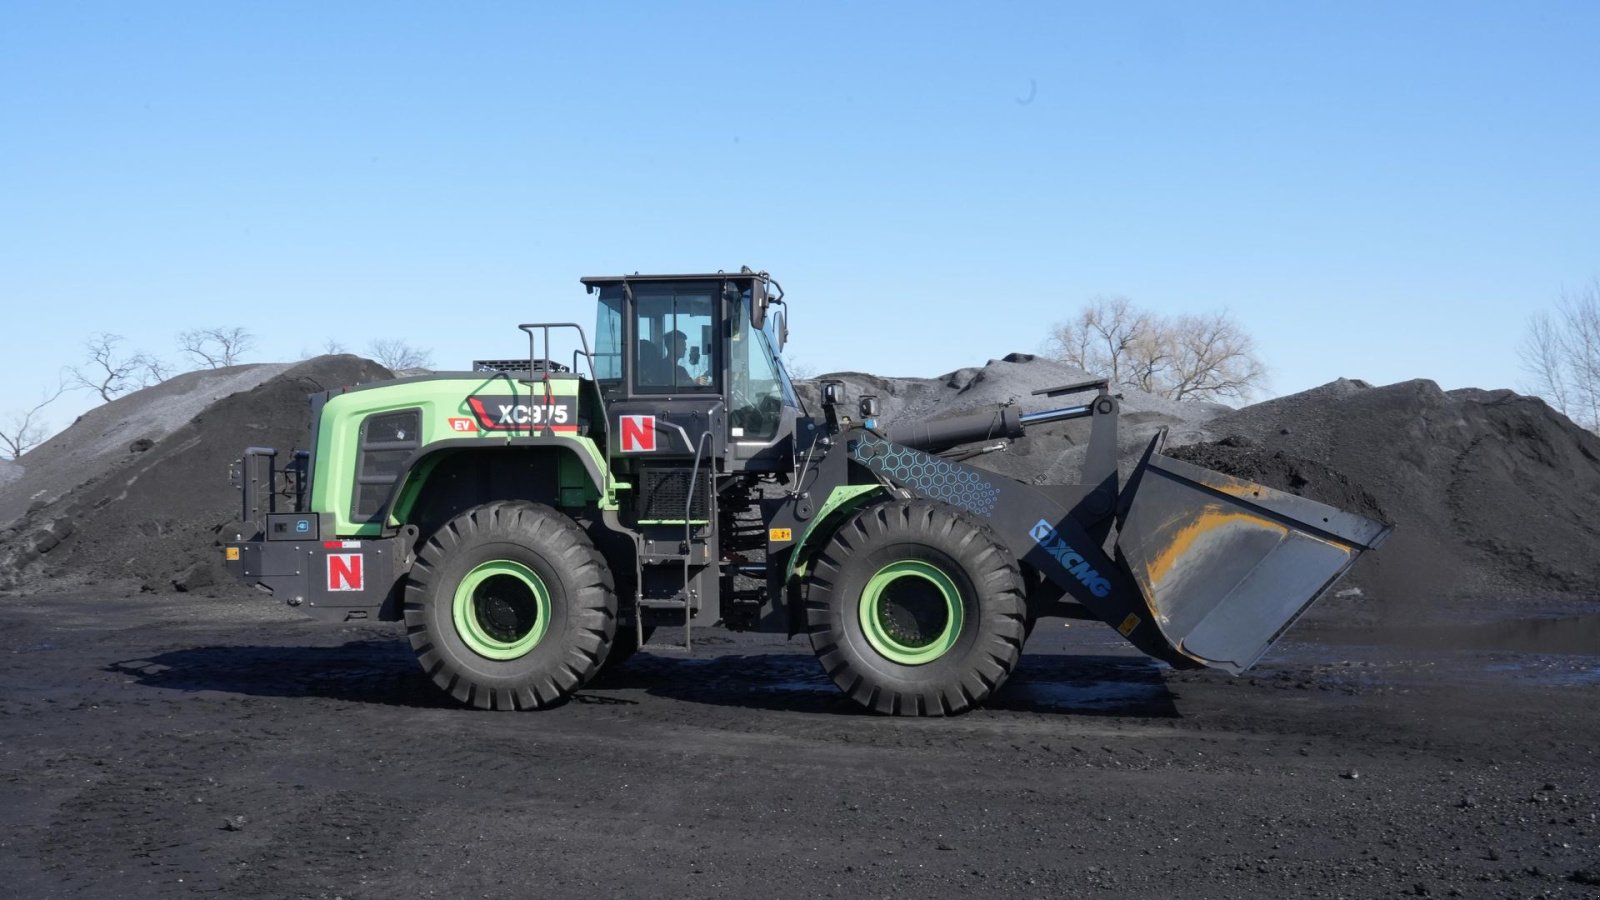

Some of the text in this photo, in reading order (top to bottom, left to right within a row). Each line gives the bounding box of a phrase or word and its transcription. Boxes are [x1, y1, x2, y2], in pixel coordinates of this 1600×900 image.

[454, 420, 470, 430] EV
[498, 404, 568, 424] XC975
[621, 416, 653, 450] N
[329, 555, 362, 590] N
[1044, 538, 1112, 598] XCMG
